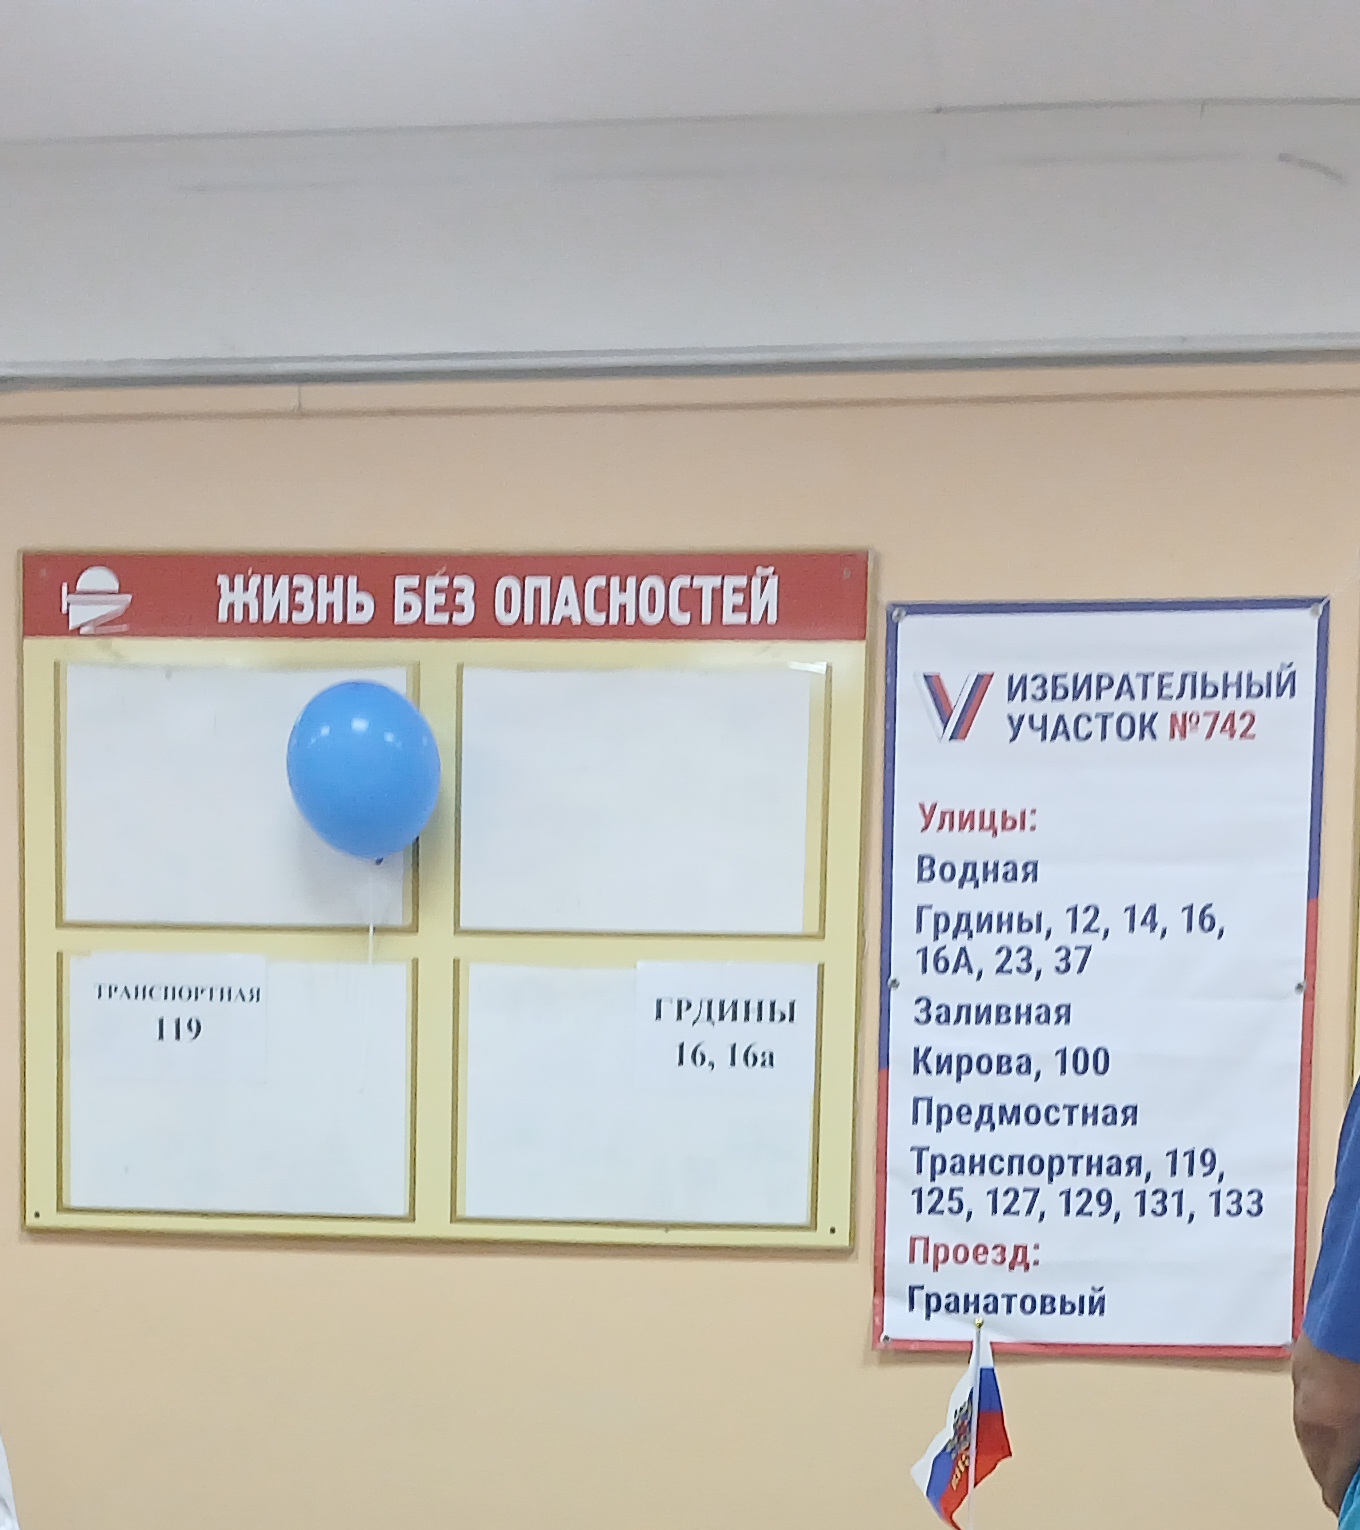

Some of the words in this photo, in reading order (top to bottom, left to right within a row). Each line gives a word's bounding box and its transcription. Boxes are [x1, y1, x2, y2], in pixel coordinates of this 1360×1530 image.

[217, 573, 375, 625] ЖИЗНЬ
[393, 574, 476, 626] БЕЗ
[494, 566, 779, 626] ОПАСНОСТЕЙ
[1006, 662, 1298, 702] ИЗБИРАТЕЛЬНЫЙ
[1007, 711, 1158, 743] УЧАСТОК
[1169, 710, 1257, 741] №742
[918, 802, 1038, 838] Улицы:
[916, 854, 1039, 889] Водная
[915, 904, 1053, 942] Грдины,
[1066, 904, 1110, 940] 12,
[1124, 903, 1167, 940] 14,
[1182, 902, 1226, 939] 16,
[916, 946, 983, 981] 16А,
[995, 945, 1042, 981] 23,
[1054, 944, 1093, 974] 37
[94, 983, 262, 1002] ТРАНСПОРТНАЯ
[155, 1015, 202, 1041] 119
[654, 997, 797, 1027] ГРДИНЫ
[913, 996, 1072, 1026] Заливная
[676, 1040, 715, 1071] 16,
[729, 1041, 775, 1069] 16а
[912, 1046, 1042, 1083] Кирова,
[1054, 1046, 1110, 1076] 100
[910, 1096, 1139, 1133] Предмостная
[910, 1146, 1152, 1184] Транспортная,
[1165, 1147, 1225, 1183] 119,
[911, 1187, 973, 1222] 125,
[986, 1187, 1046, 1223] 127,
[1058, 1188, 1121, 1224] 129,
[1134, 1188, 1195, 1224] 131,
[1208, 1188, 1265, 1218] 133
[908, 1236, 1041, 1272] Проезд:
[907, 1284, 1106, 1320] Гранатовый
